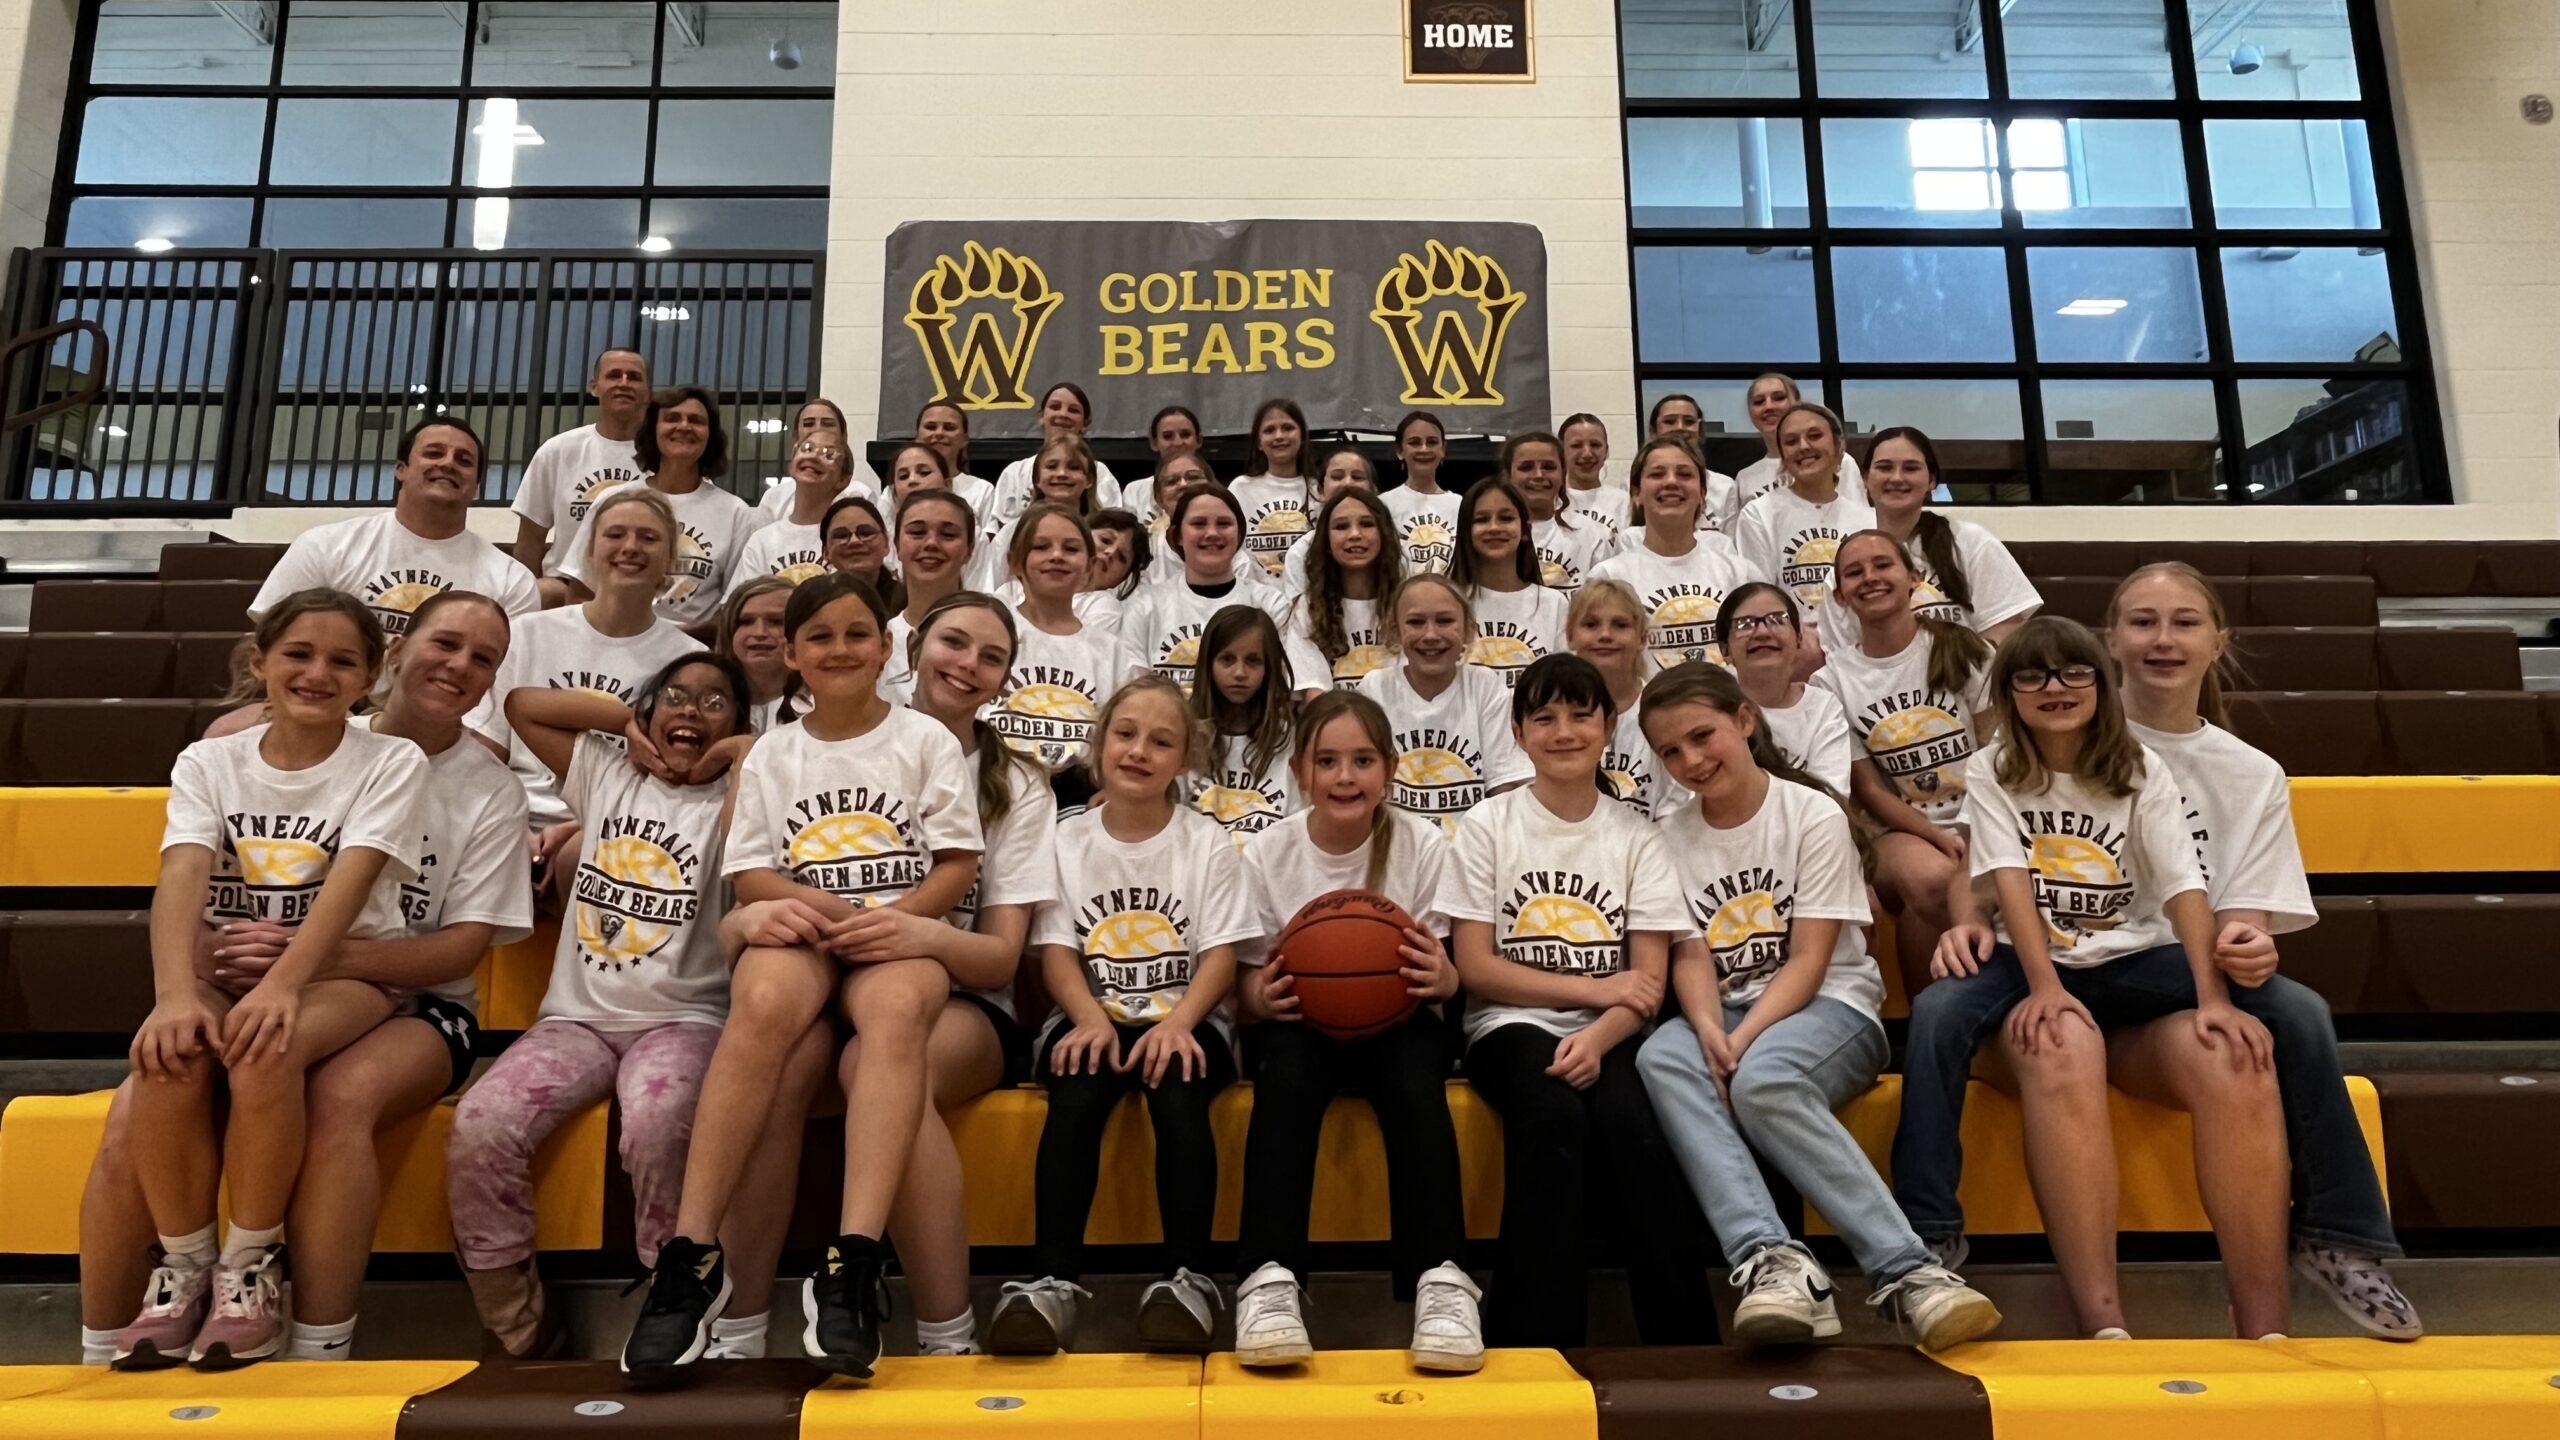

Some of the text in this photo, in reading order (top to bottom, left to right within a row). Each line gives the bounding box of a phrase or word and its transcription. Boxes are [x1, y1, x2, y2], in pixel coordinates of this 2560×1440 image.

[1423, 24, 1514, 48] HOME
[1100, 268, 1334, 314] GOLDEN
[1099, 318, 1336, 376] BEARS
[1395, 729, 1482, 768] YNEDALE
[1438, 787, 1482, 808] BEAR
[629, 892, 698, 921] BEARS
[1501, 870, 1626, 926] WAYNEDALE
